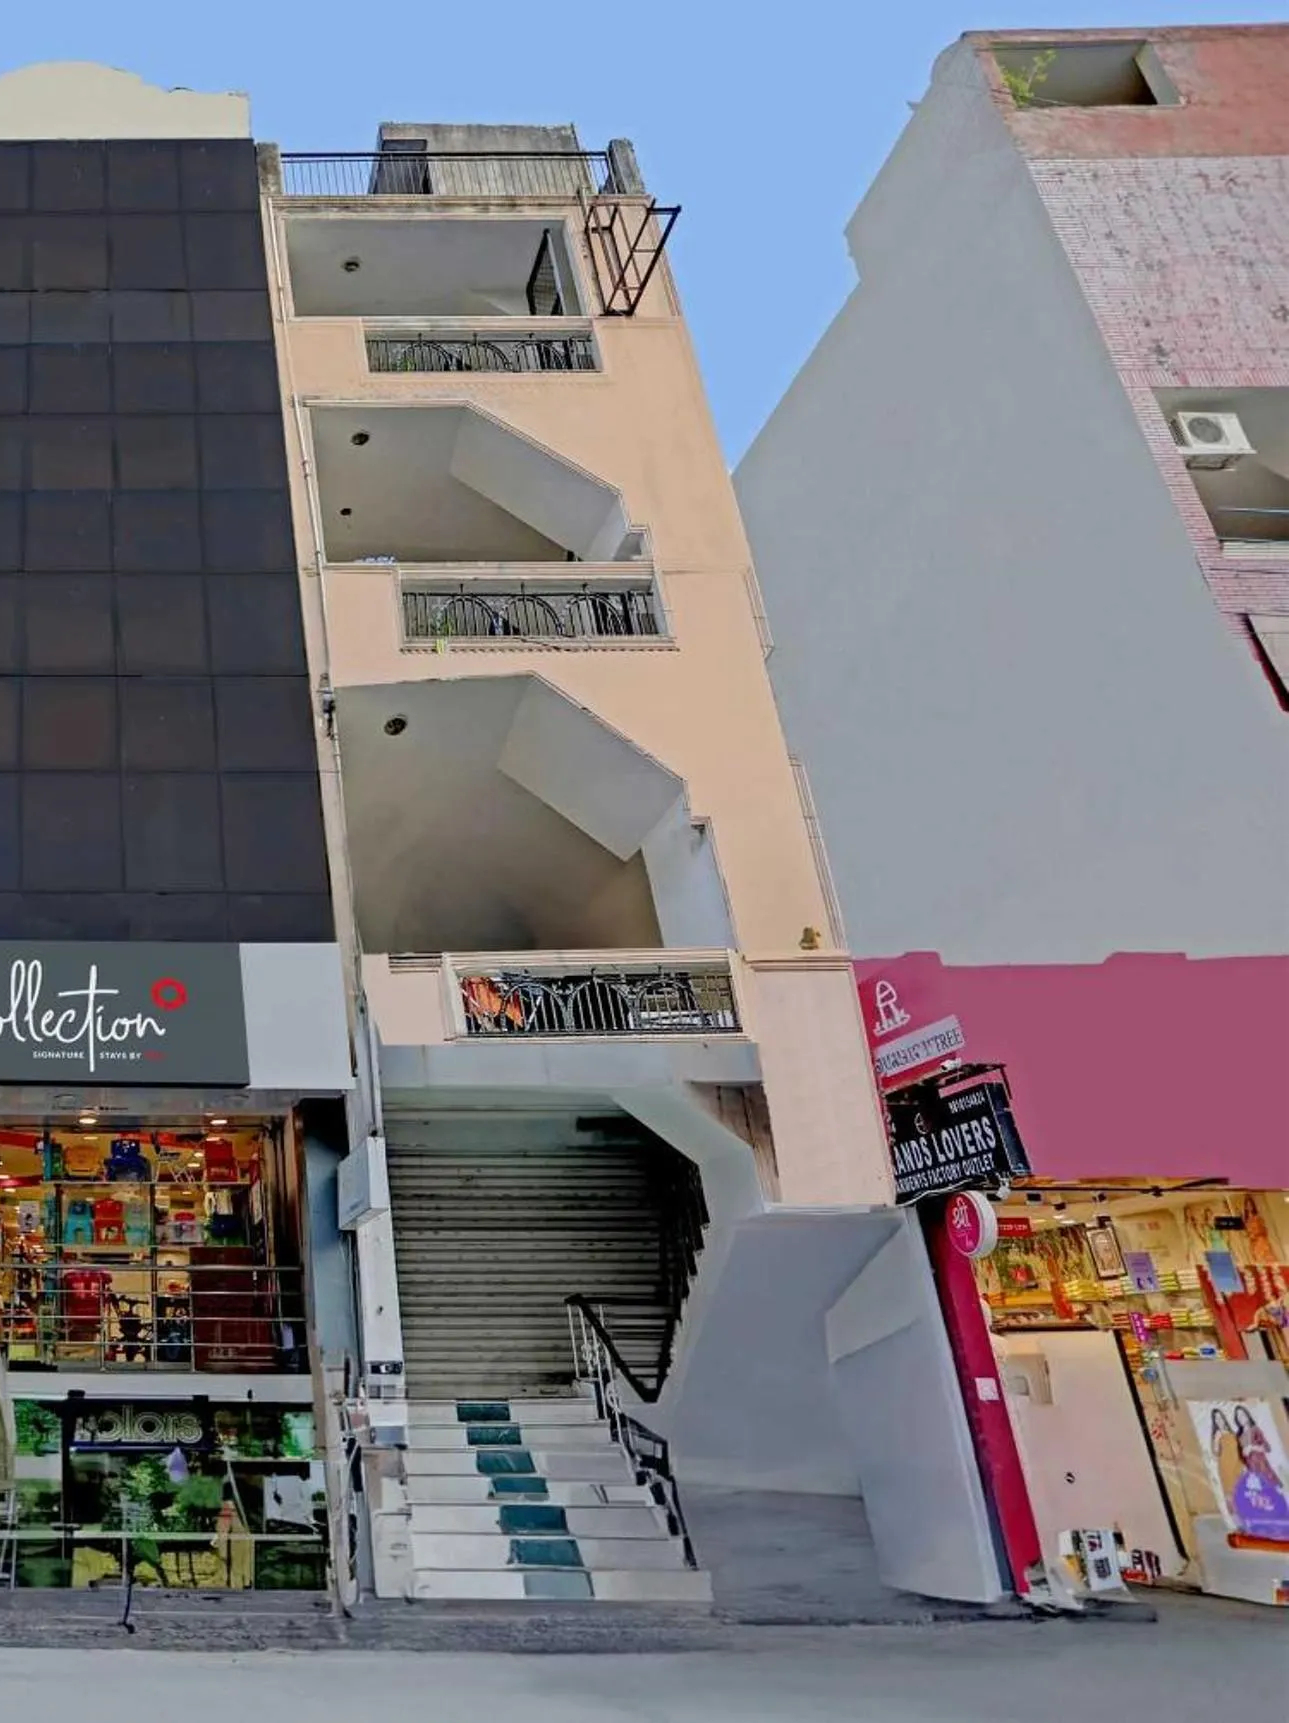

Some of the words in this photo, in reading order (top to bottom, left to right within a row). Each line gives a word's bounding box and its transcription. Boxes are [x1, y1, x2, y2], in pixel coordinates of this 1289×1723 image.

[32, 1051, 85, 1059] SIGNATURE
[99, 1052, 127, 1060] STAYS
[129, 1052, 143, 1060] BY
[893, 1136, 932, 1176] ANDS
[931, 1116, 996, 1163] LOVERS
[927, 1162, 961, 1186] FACTORY
[961, 1152, 995, 1177] OUTLET
